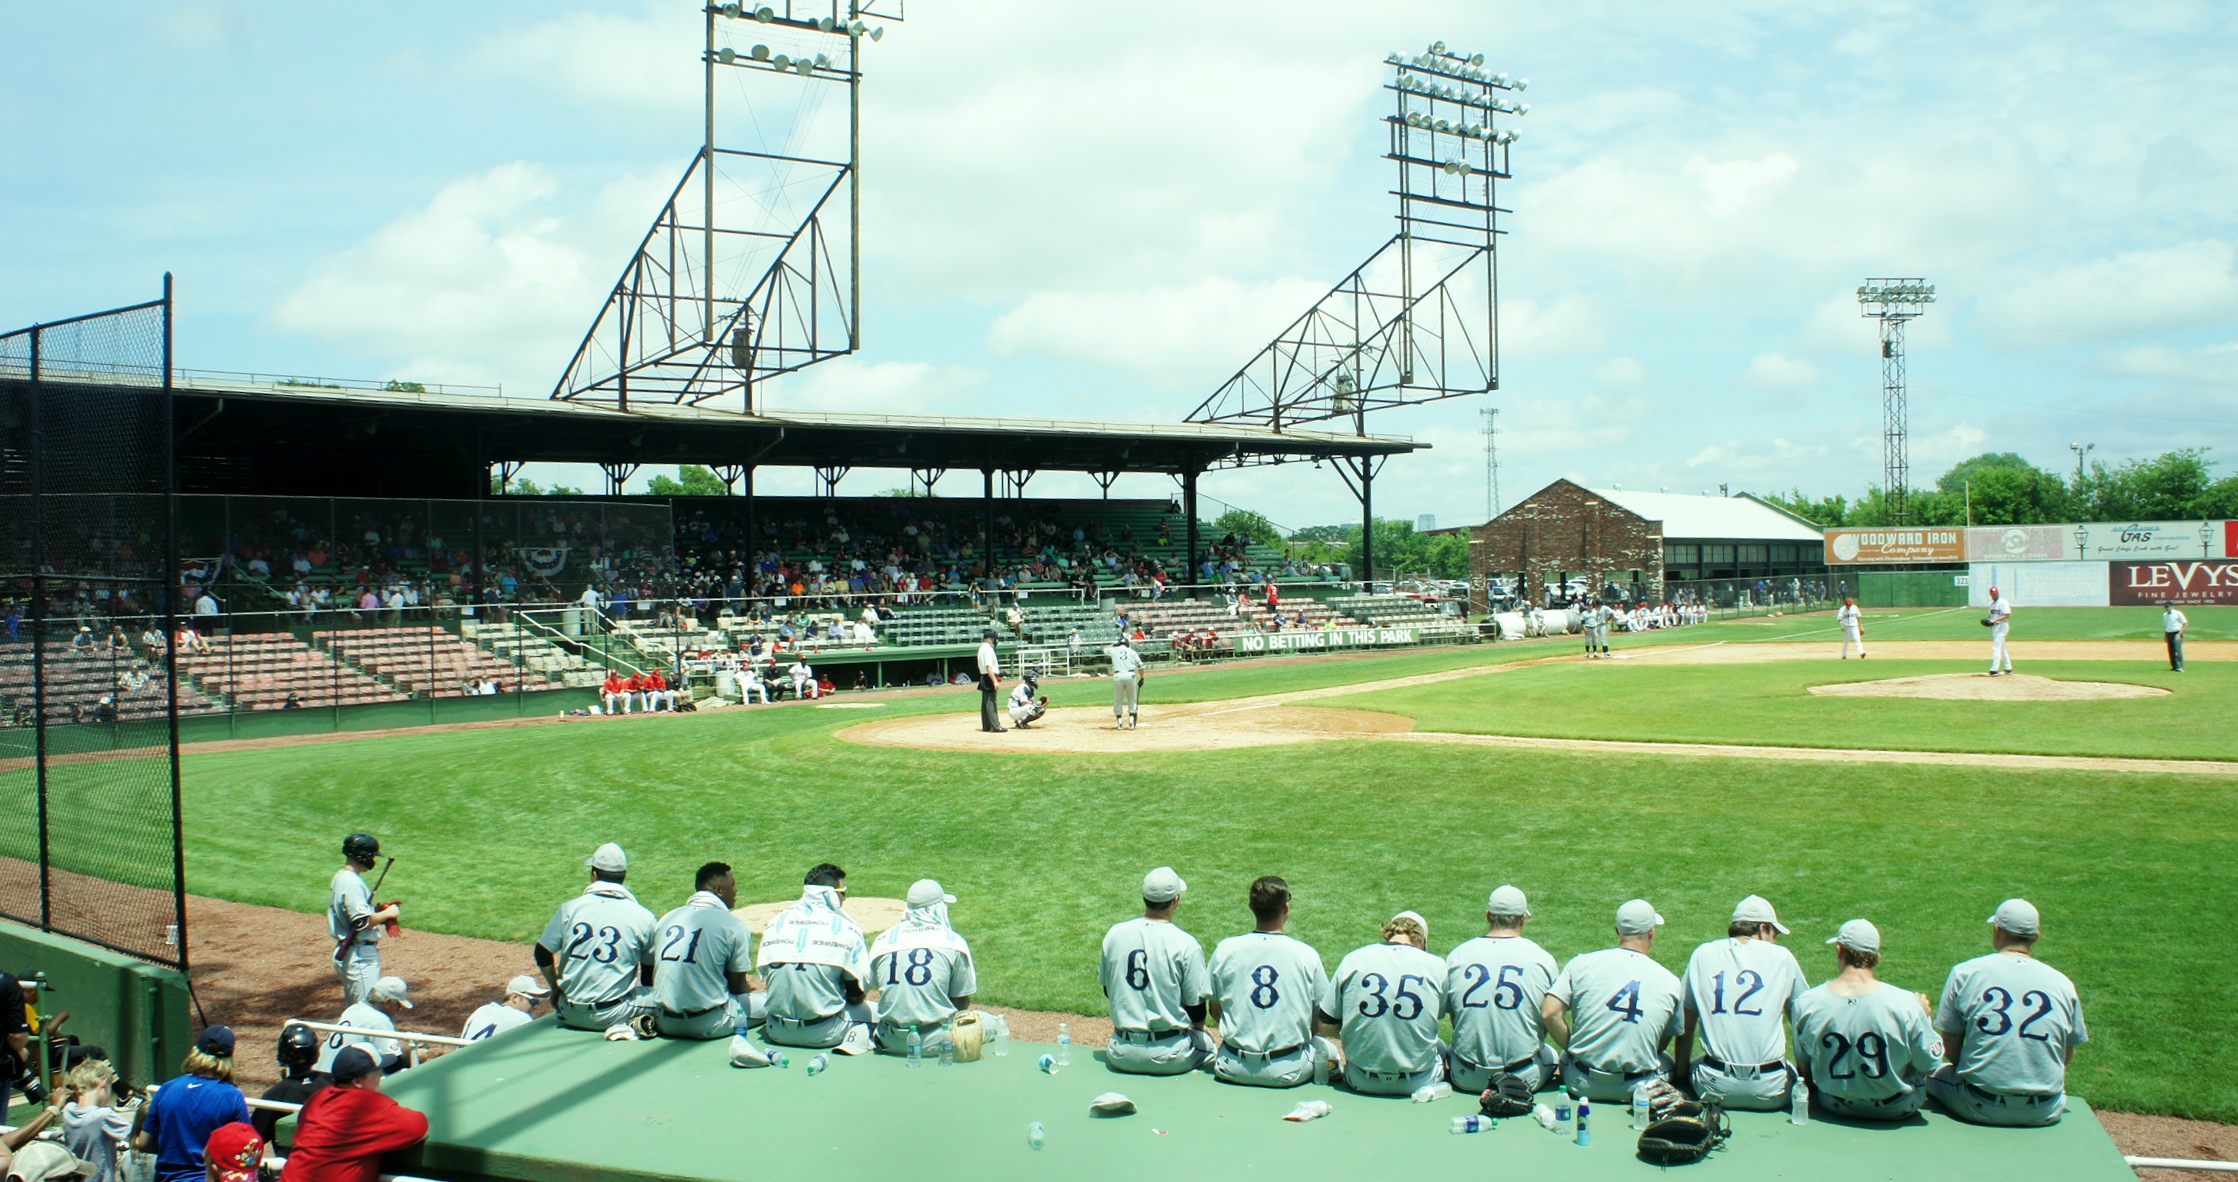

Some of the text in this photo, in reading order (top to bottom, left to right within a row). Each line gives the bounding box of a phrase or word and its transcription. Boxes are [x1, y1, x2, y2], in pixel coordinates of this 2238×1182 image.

[1849, 532, 1957, 546] WOODWARD IRON
[1881, 543, 1934, 556] Company
[2120, 524, 2152, 543] GAS
[1119, 650, 1128, 661] 3
[1242, 629, 1413, 650] NO BETTING IN THIS PARK
[569, 922, 622, 963] 23
[661, 924, 703, 964] 21
[887, 947, 934, 986] 18
[1125, 949, 1150, 990] 6
[1250, 964, 1280, 1010] 8
[1462, 963, 1525, 1010] 25
[1359, 972, 1424, 1020] 35
[1605, 979, 1644, 1024] 4
[1711, 969, 1765, 1015] 12
[1976, 986, 2053, 1041] 32
[846, 1030, 857, 1043] B
[1822, 1031, 1888, 1079] 29
